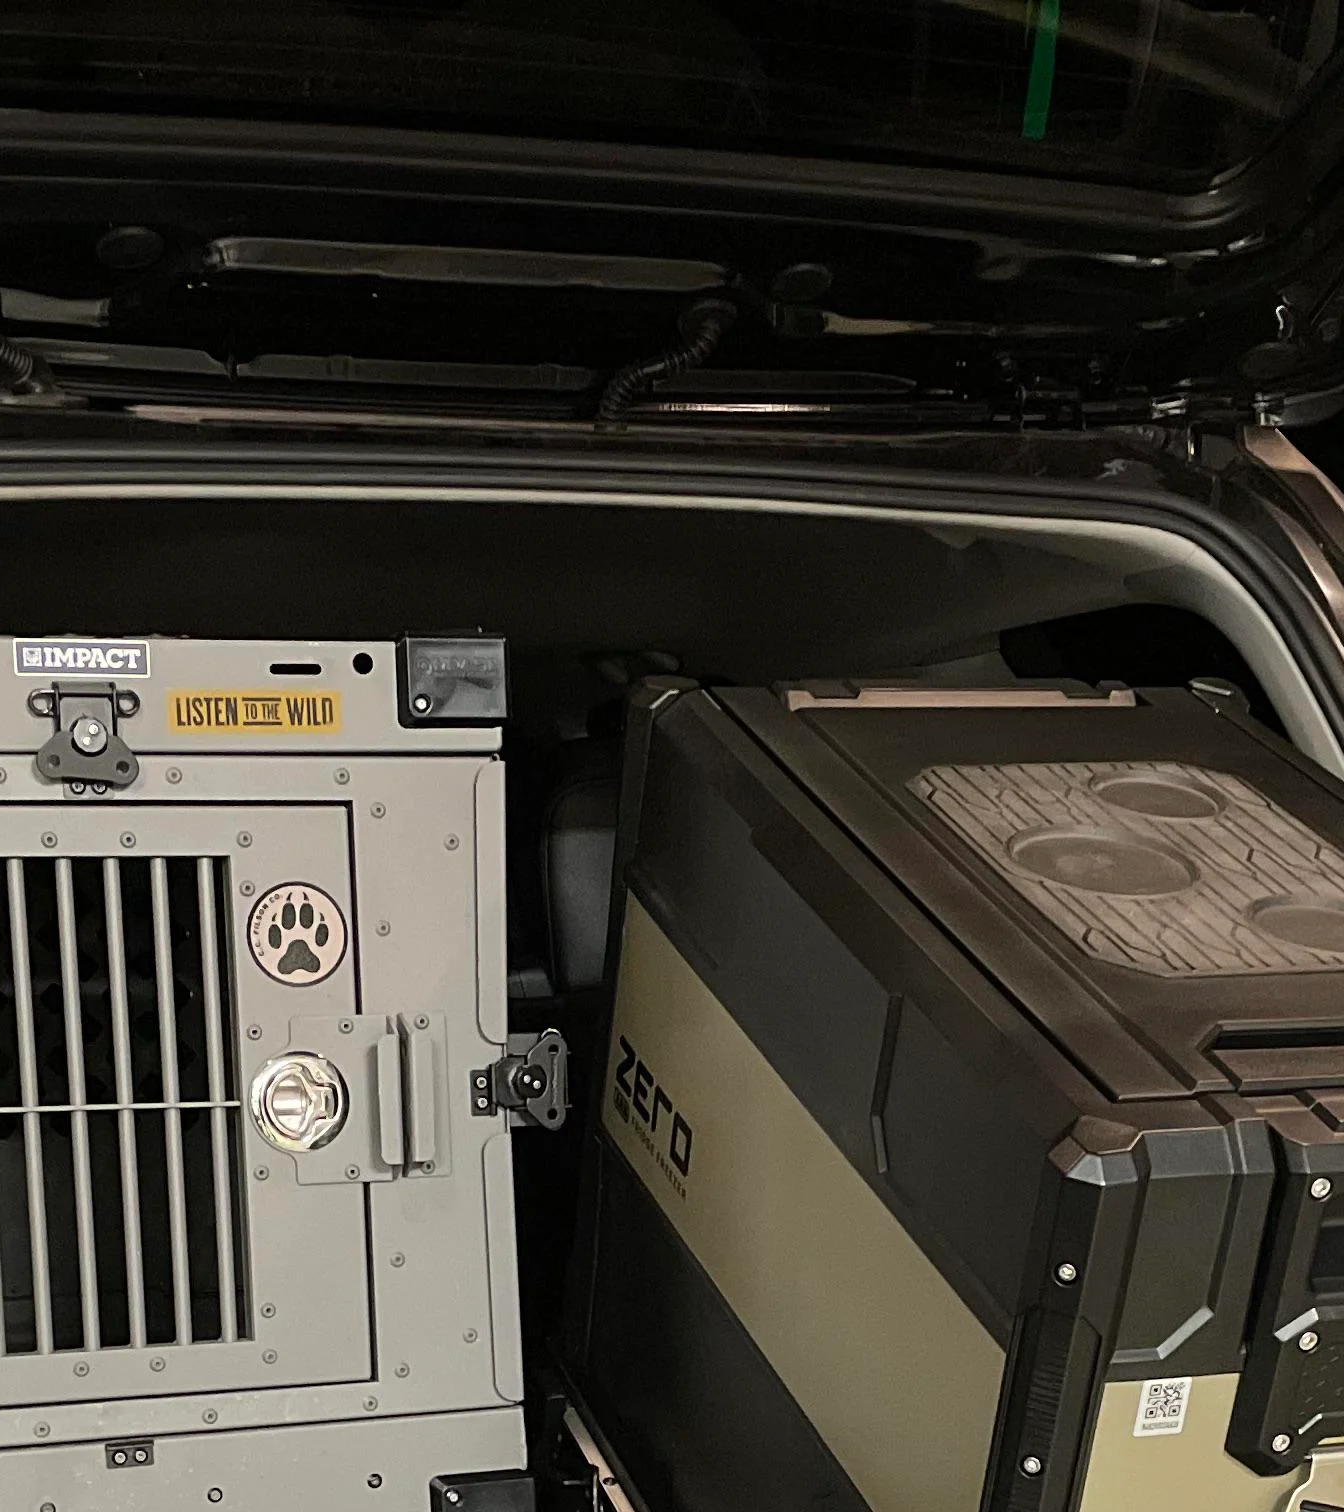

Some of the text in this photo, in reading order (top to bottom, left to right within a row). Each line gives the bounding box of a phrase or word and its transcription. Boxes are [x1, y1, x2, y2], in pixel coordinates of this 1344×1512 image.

[45, 647, 141, 669] IMPACT
[175, 697, 334, 727] LISTEN TO THE WILD
